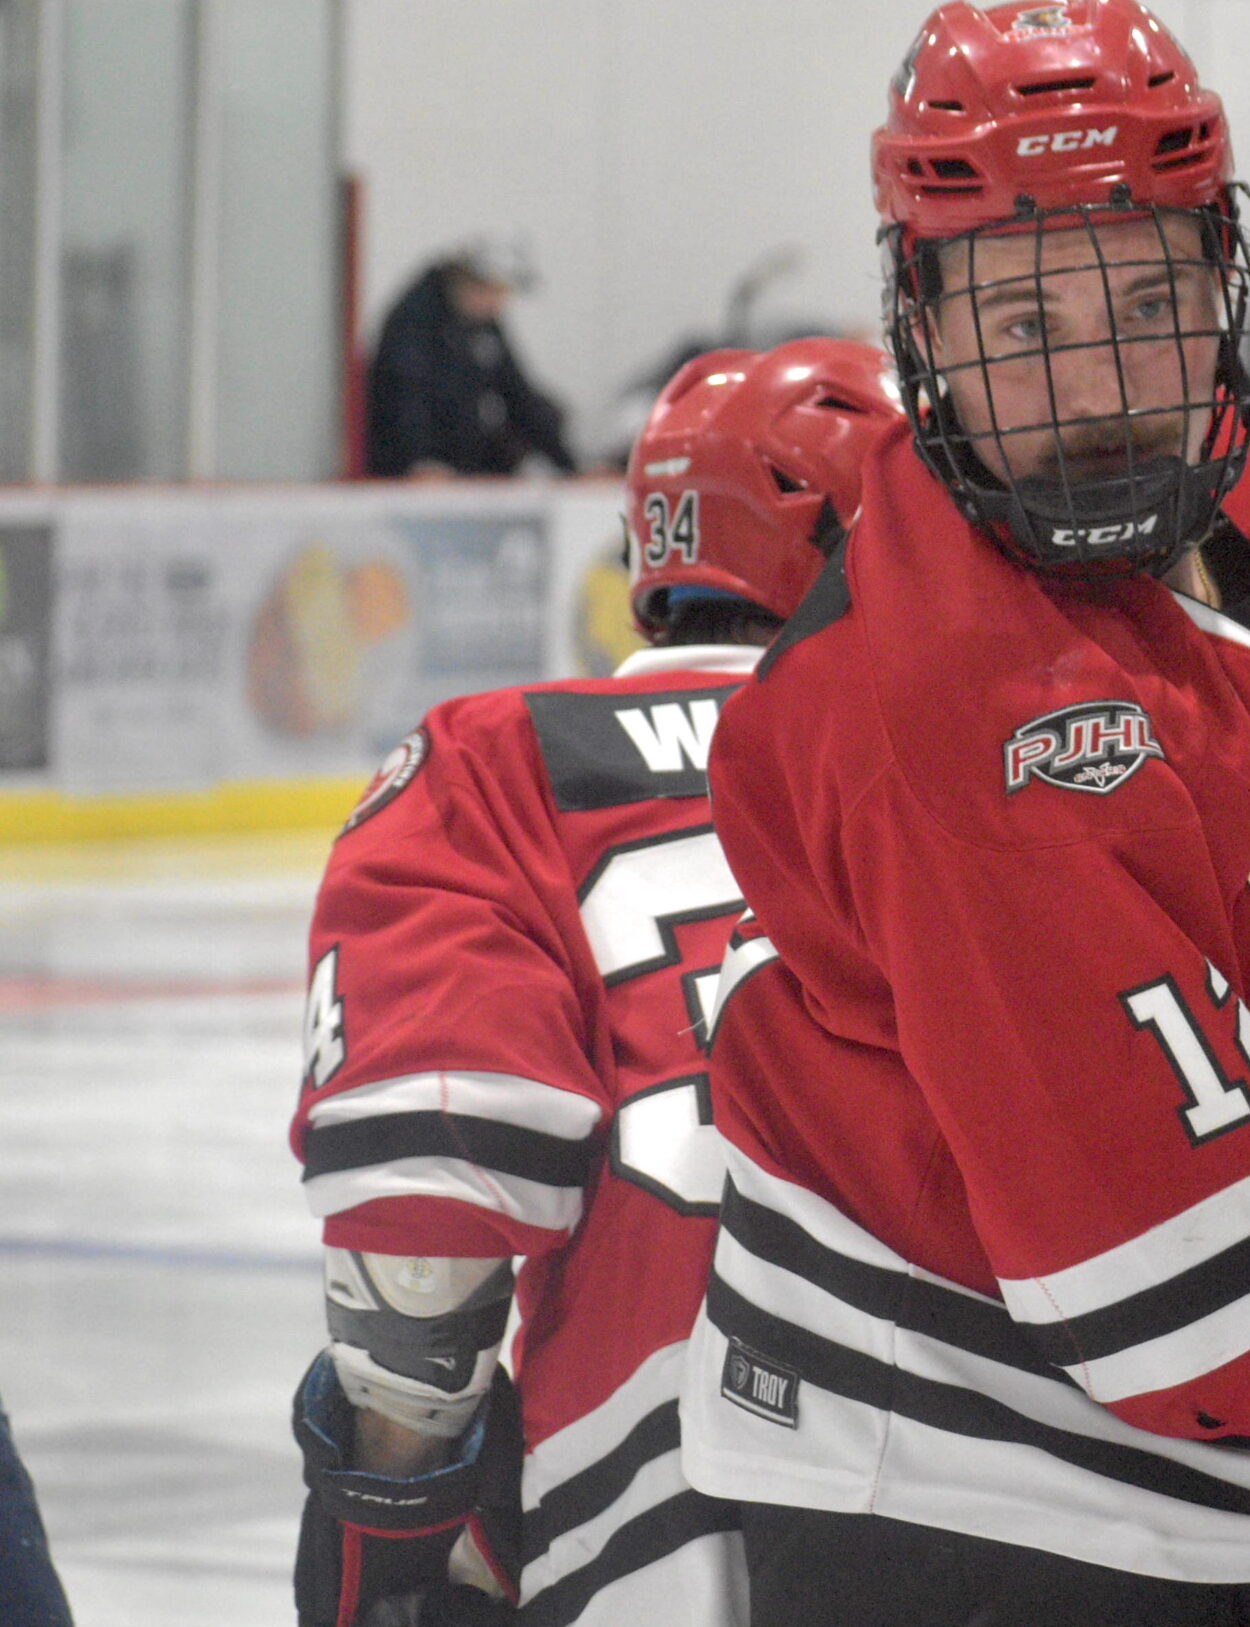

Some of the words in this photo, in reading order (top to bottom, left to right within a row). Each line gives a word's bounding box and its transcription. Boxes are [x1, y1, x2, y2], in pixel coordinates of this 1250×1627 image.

[1016, 125, 1118, 156] CCM
[644, 489, 700, 567] 34
[1004, 712, 1166, 792] PJHL
[752, 1365, 788, 1409] TROY
